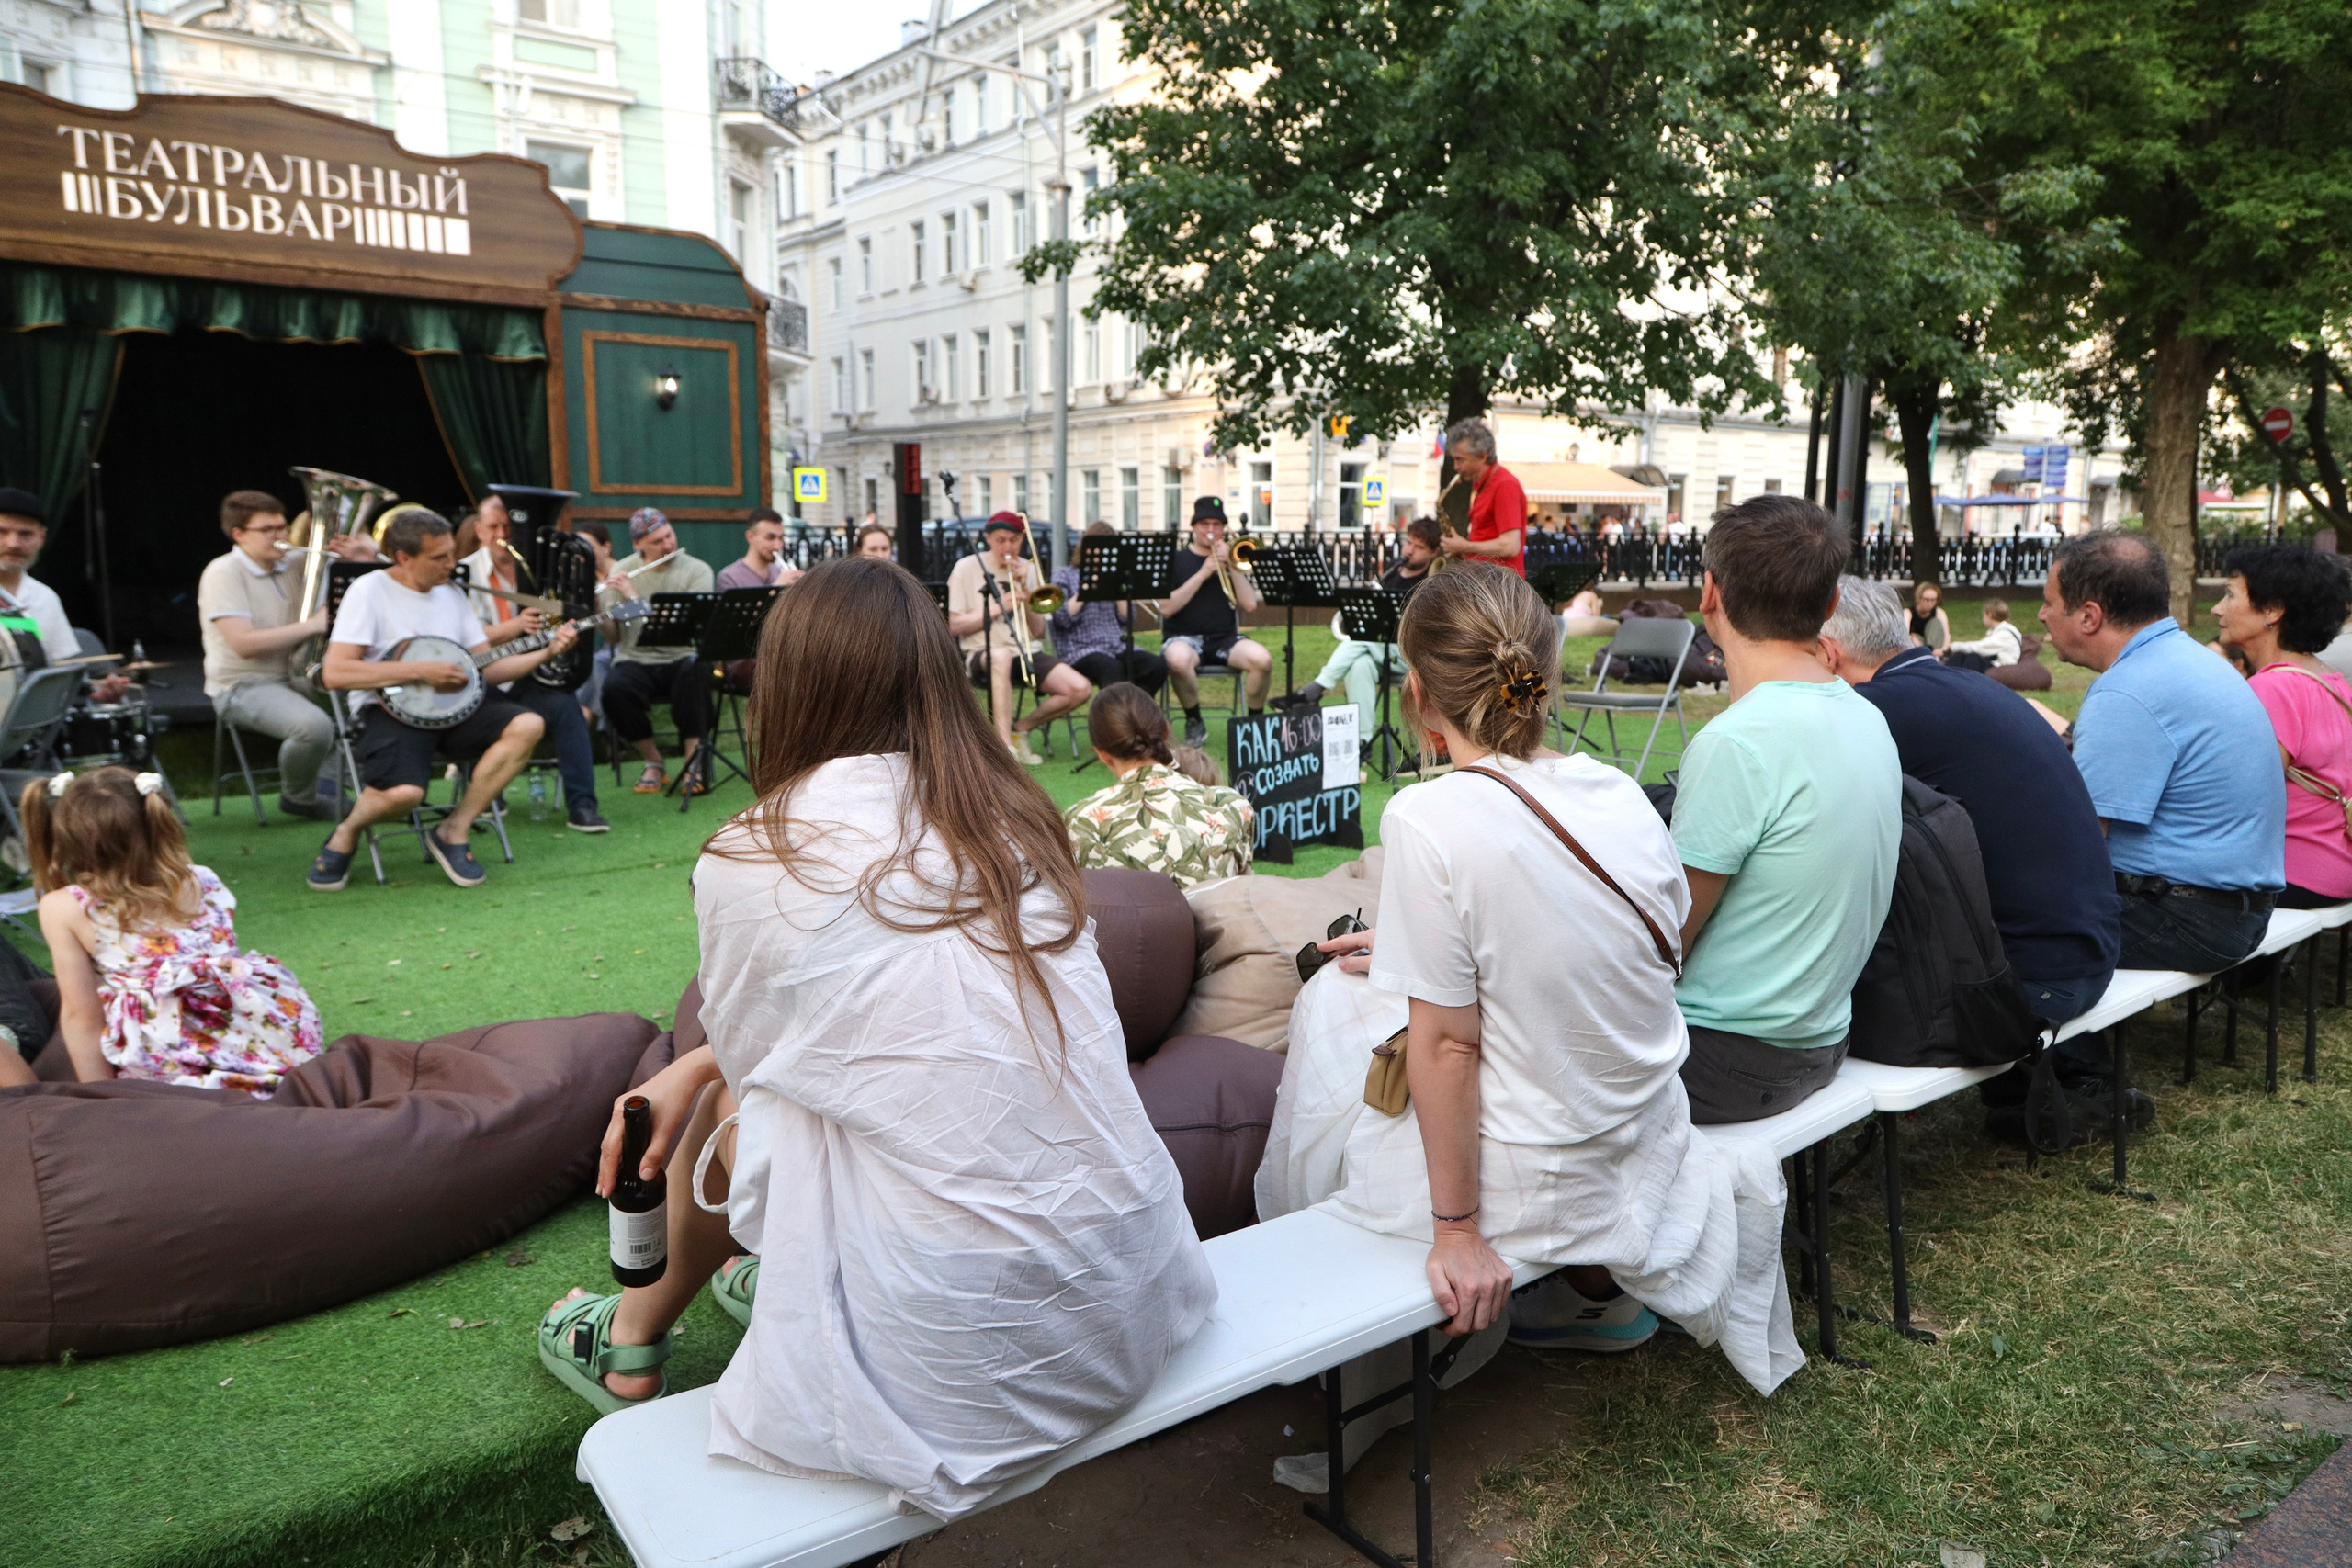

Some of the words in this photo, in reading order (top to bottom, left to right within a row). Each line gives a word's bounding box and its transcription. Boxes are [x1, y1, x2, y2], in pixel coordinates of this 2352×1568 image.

[57, 125, 469, 215] ТЕАТРАЛЬНЫЙ
[107, 176, 355, 242] БУЛЬВАР
[1236, 716, 1281, 768] КАК
[1281, 713, 1323, 752] 16:00
[1255, 752, 1320, 795] СОЗДАТЬ
